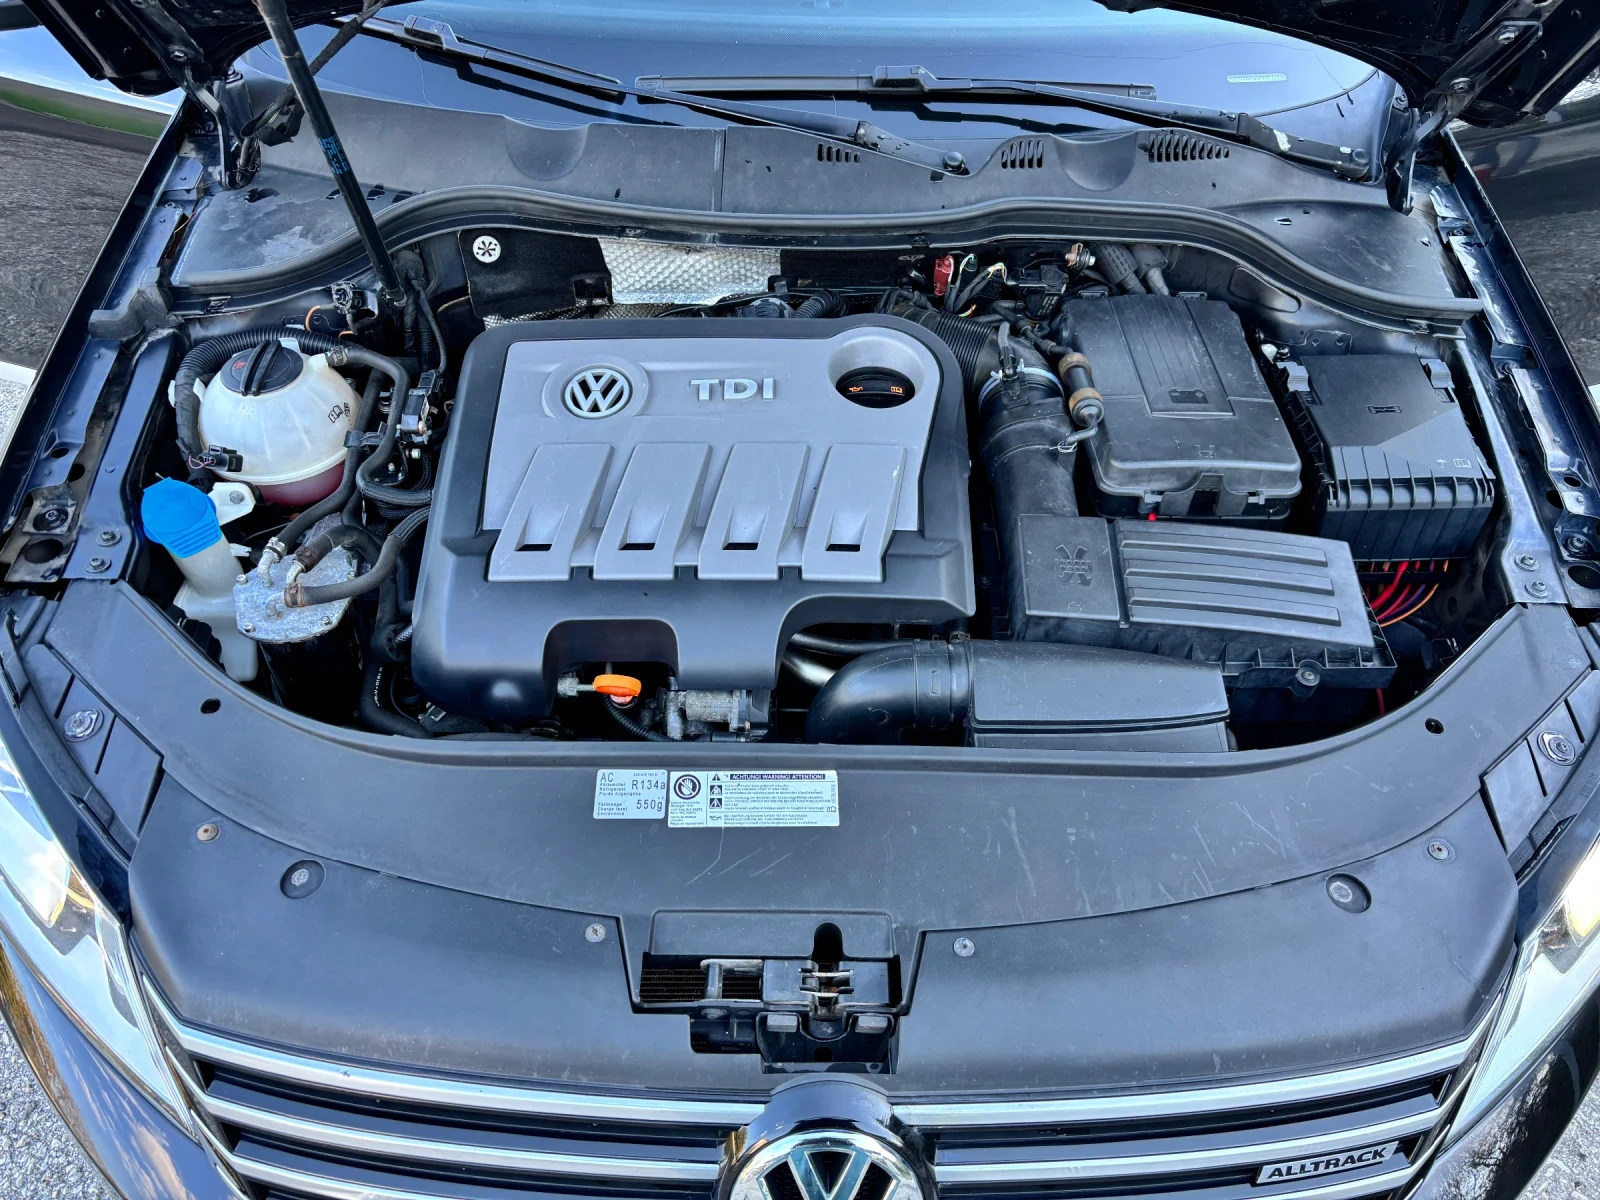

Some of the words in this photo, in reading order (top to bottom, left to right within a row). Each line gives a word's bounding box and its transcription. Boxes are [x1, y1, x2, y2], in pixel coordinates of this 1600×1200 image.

[565, 369, 630, 418] VW
[690, 377, 776, 401] TDI
[600, 772, 614, 782] AC
[631, 779, 666, 790] R134a
[636, 799, 663, 812] 550g
[1266, 1147, 1388, 1180] ALLTRACK
